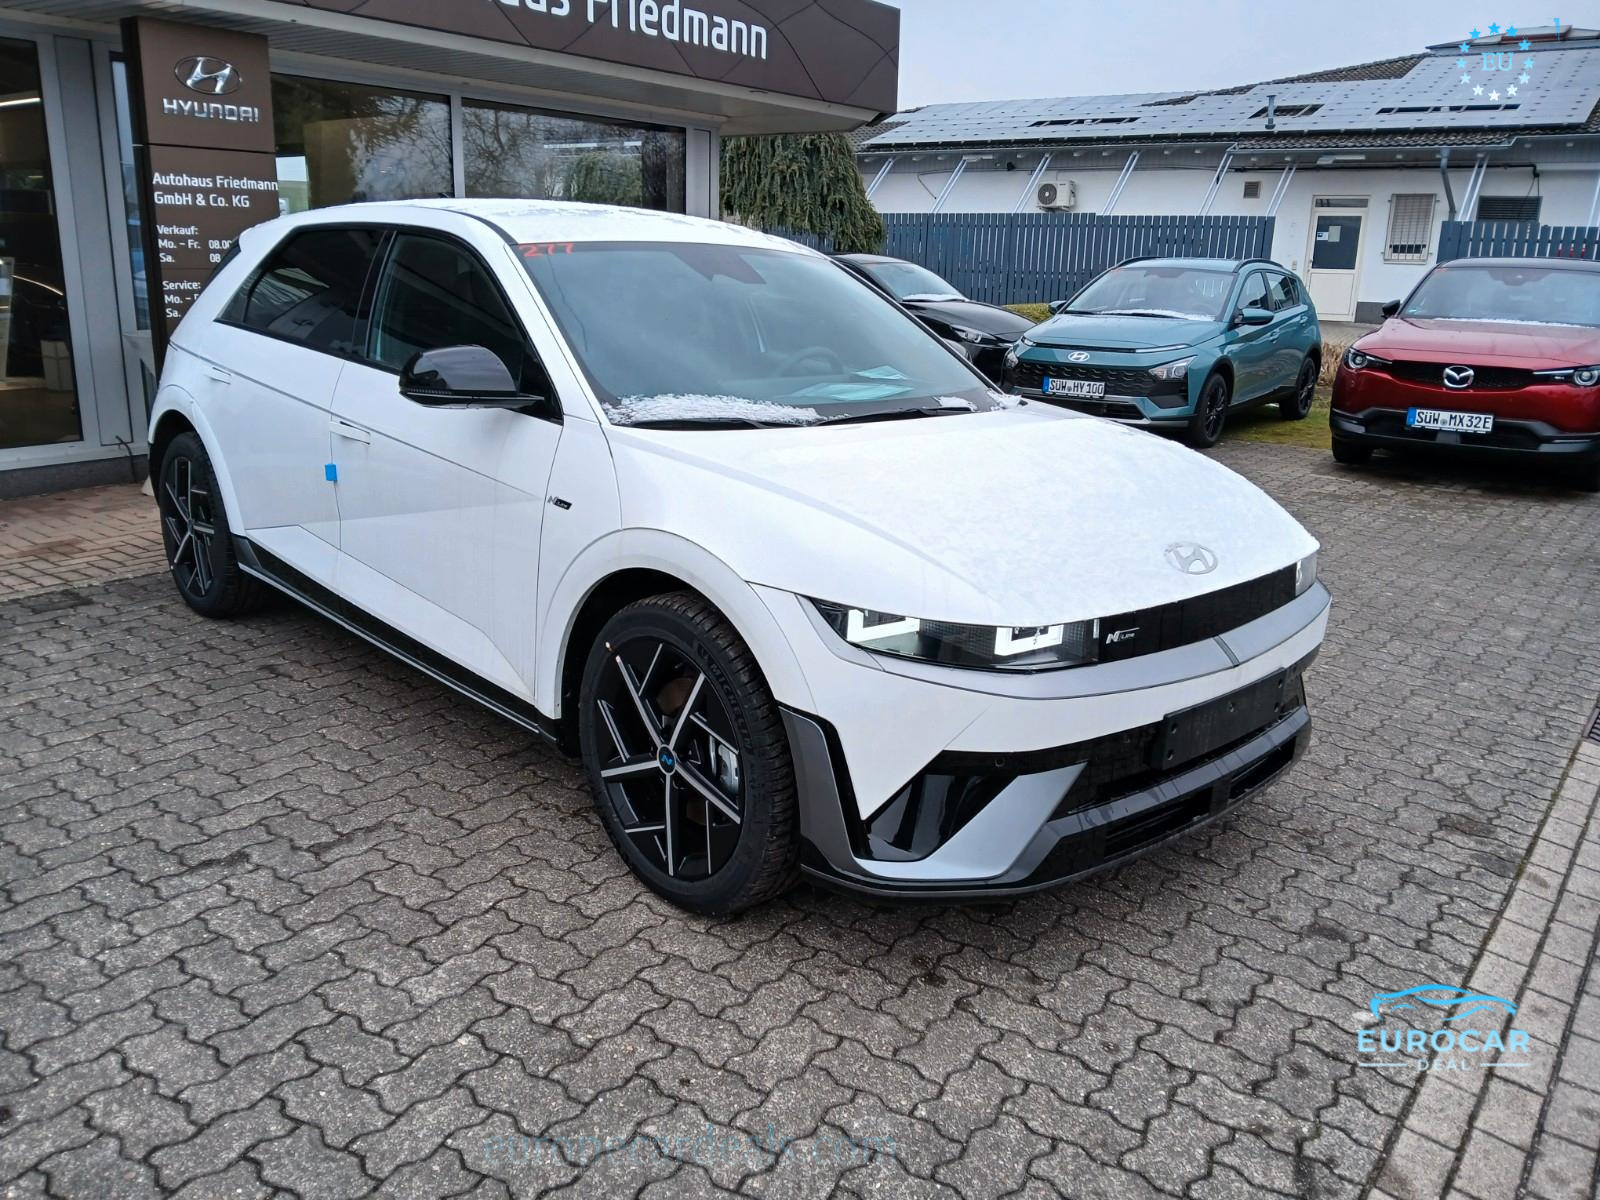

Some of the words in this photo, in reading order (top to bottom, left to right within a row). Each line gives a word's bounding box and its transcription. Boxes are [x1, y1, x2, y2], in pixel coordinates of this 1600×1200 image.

[163, 98, 259, 123] HYUNDAI
[152, 172, 213, 188] Autohaus
[216, 175, 279, 191] Friedmann
[153, 191, 192, 206] GmbH
[195, 193, 207, 206] &
[209, 194, 229, 207] Co.
[231, 195, 250, 208] KG
[157, 225, 199, 235] Verkauf:
[158, 239, 177, 249] Mo.
[187, 240, 201, 249] Fr.
[159, 252, 176, 263] Sa.
[162, 281, 201, 290] Service:
[164, 294, 184, 304] Mo.
[165, 308, 182, 318] Sa.
